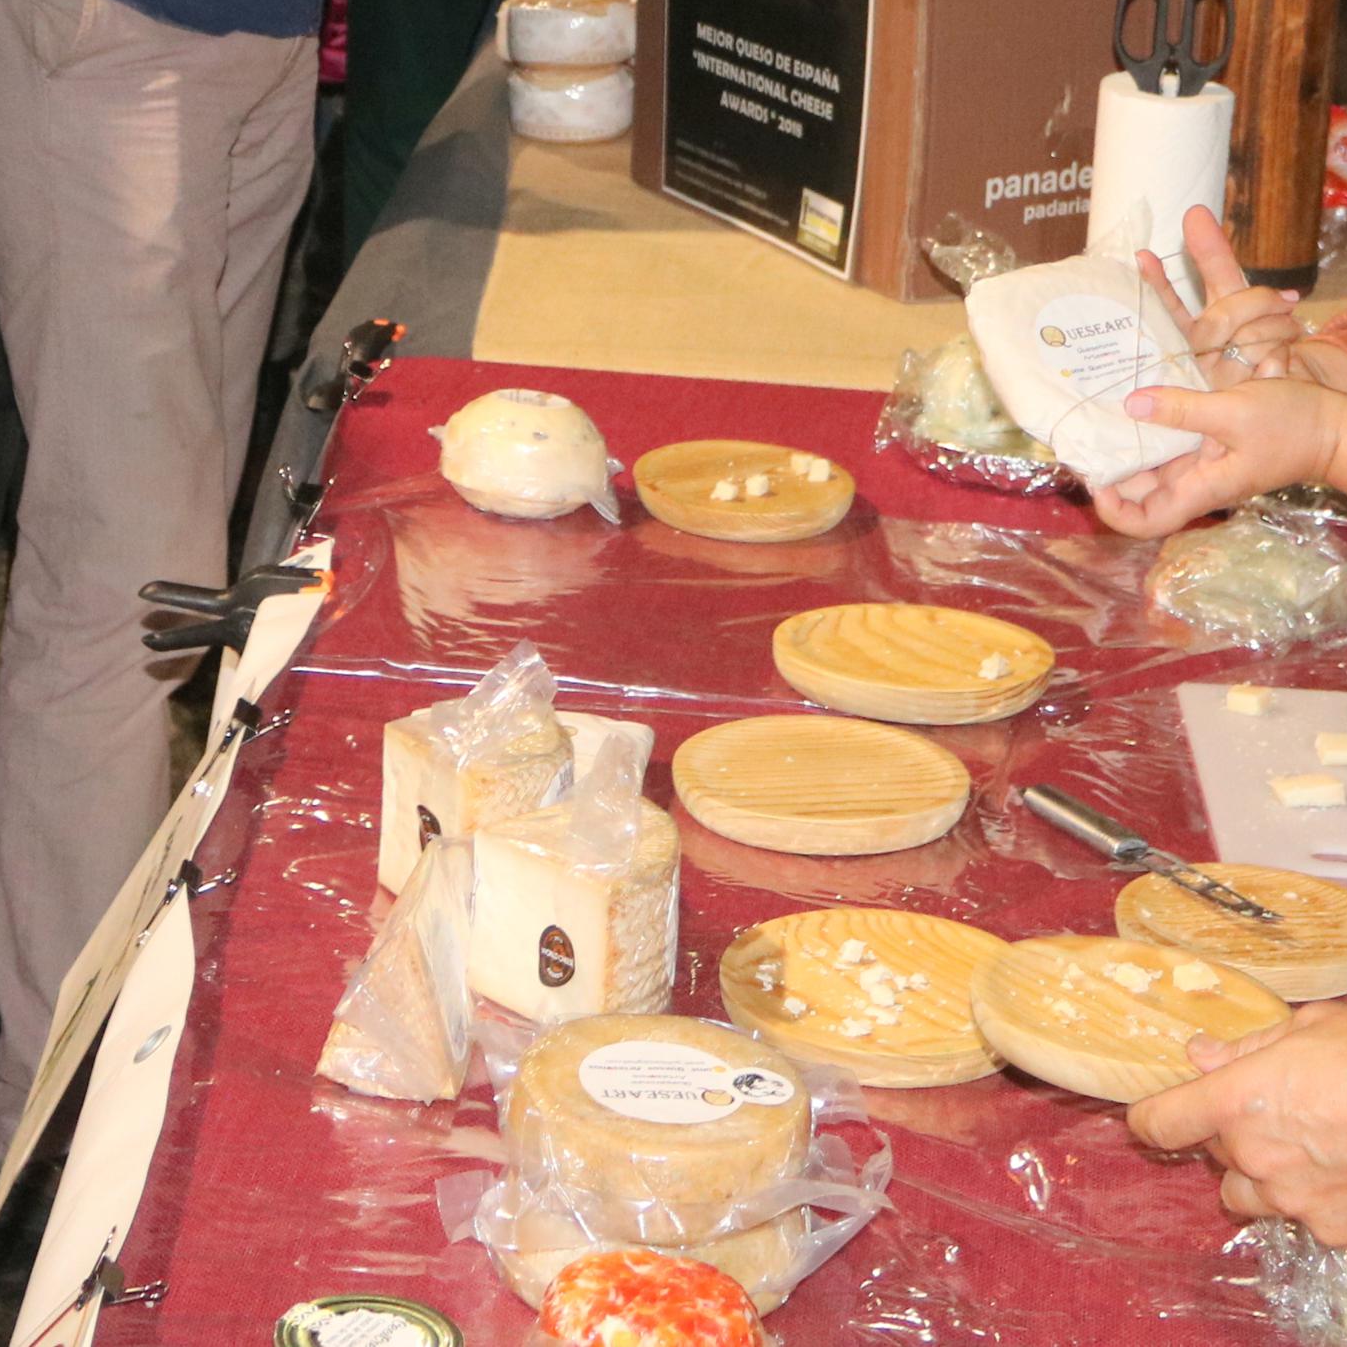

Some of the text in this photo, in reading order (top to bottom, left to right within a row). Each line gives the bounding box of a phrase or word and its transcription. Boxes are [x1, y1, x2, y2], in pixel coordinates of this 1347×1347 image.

[696, 21, 840, 93] MEJOR QUESO DE ESPAÑA
[719, 91, 769, 124] AWARDS
[790, 88, 833, 121] CHEESE
[984, 160, 1094, 209] panade
[1023, 196, 1091, 225] padaria
[1040, 316, 1134, 348] QUESEART
